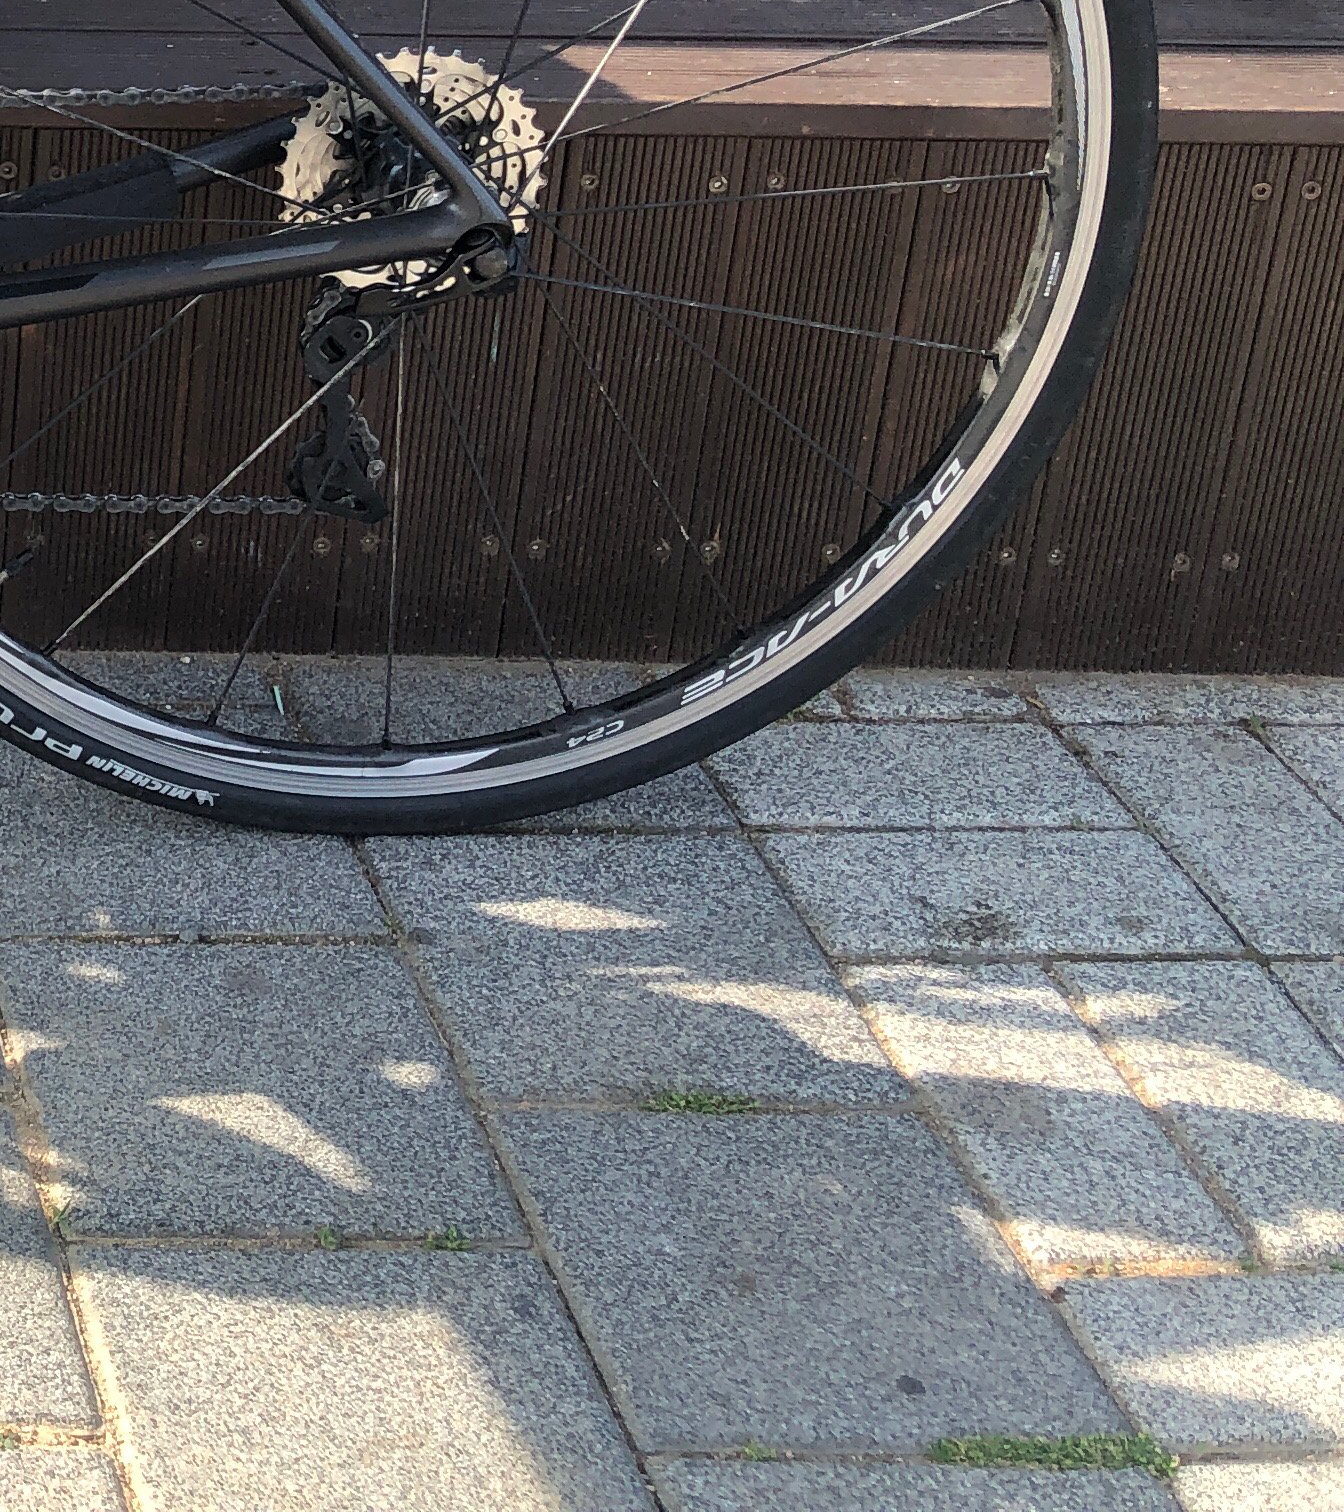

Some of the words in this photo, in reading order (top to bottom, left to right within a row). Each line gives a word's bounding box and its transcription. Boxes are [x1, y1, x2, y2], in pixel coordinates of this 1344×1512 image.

[680, 457, 965, 706] DURA-ACE
[566, 718, 626, 748] C24
[85, 753, 194, 802] MICHELIN
